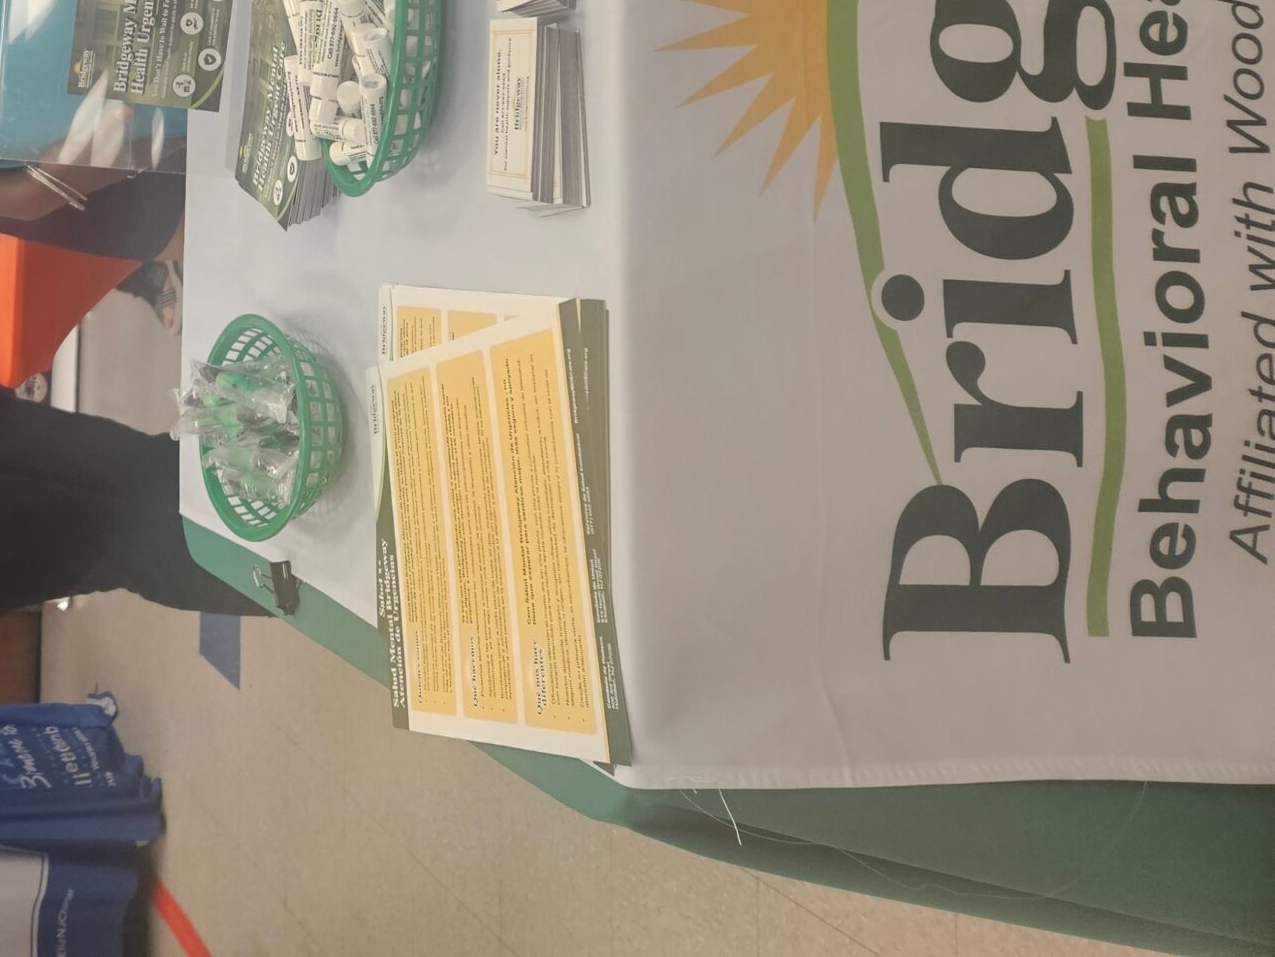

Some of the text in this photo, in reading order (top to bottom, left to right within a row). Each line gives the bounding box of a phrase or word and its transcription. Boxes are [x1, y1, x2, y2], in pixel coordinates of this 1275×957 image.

[113, 18, 137, 92] Bridgeway
[156, 45, 164, 62] Have
[158, 17, 166, 33] Wait
[77, 50, 91, 88] Bridgeway
[130, 48, 149, 94] Health
[153, 63, 162, 82] Don't
[514, 76, 522, 130] Bridgeway
[1232, 181, 1275, 293] with
[1129, 154, 1213, 639] Behavioral
[1228, 311, 1275, 565] Affiliated
[380, 538, 399, 708] Salud Mental Bridgeway
[389, 554, 405, 708] Atención de Urgencias
